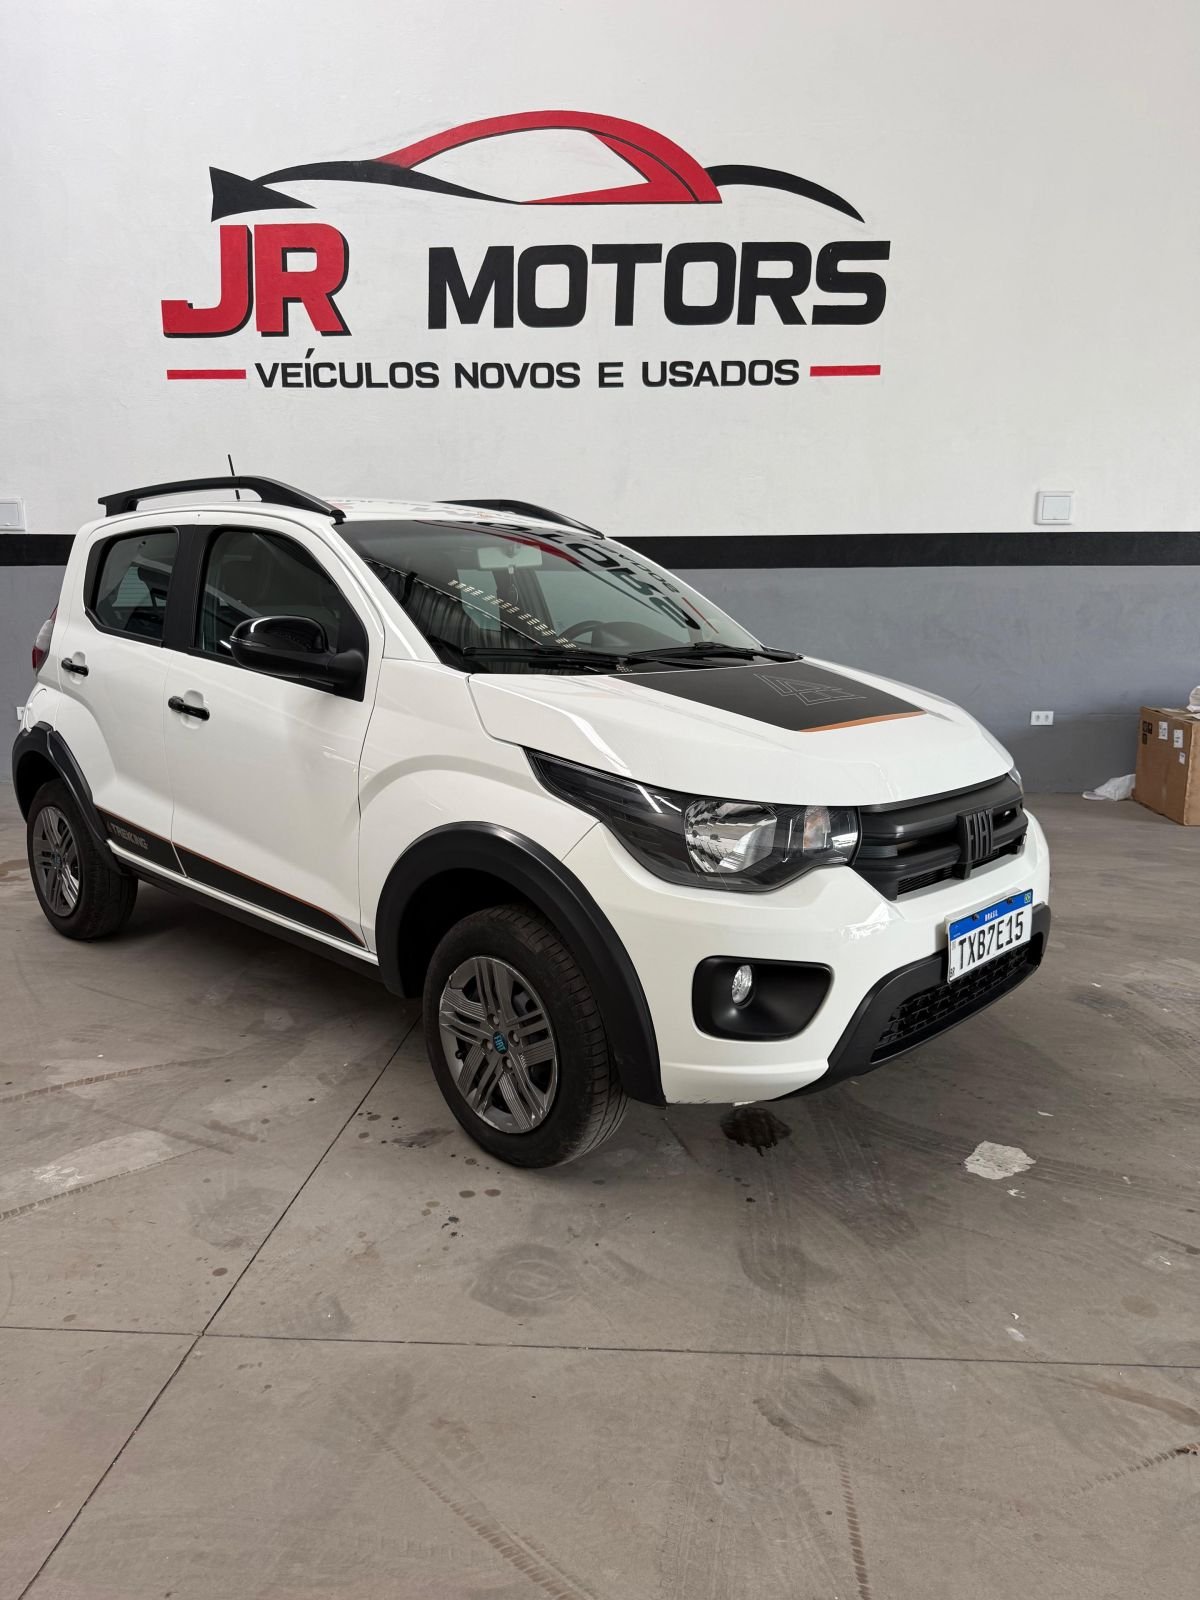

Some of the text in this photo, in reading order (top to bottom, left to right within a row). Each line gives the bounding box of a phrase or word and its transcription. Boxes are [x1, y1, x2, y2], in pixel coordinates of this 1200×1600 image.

[161, 223, 890, 338] JR MOTORS
[255, 348, 799, 388] VEÍCULOS NOVOS E USADOS
[966, 809, 993, 862] FIAT
[958, 911, 1024, 970] TXB7E15
[494, 1035, 506, 1052] FIAT
